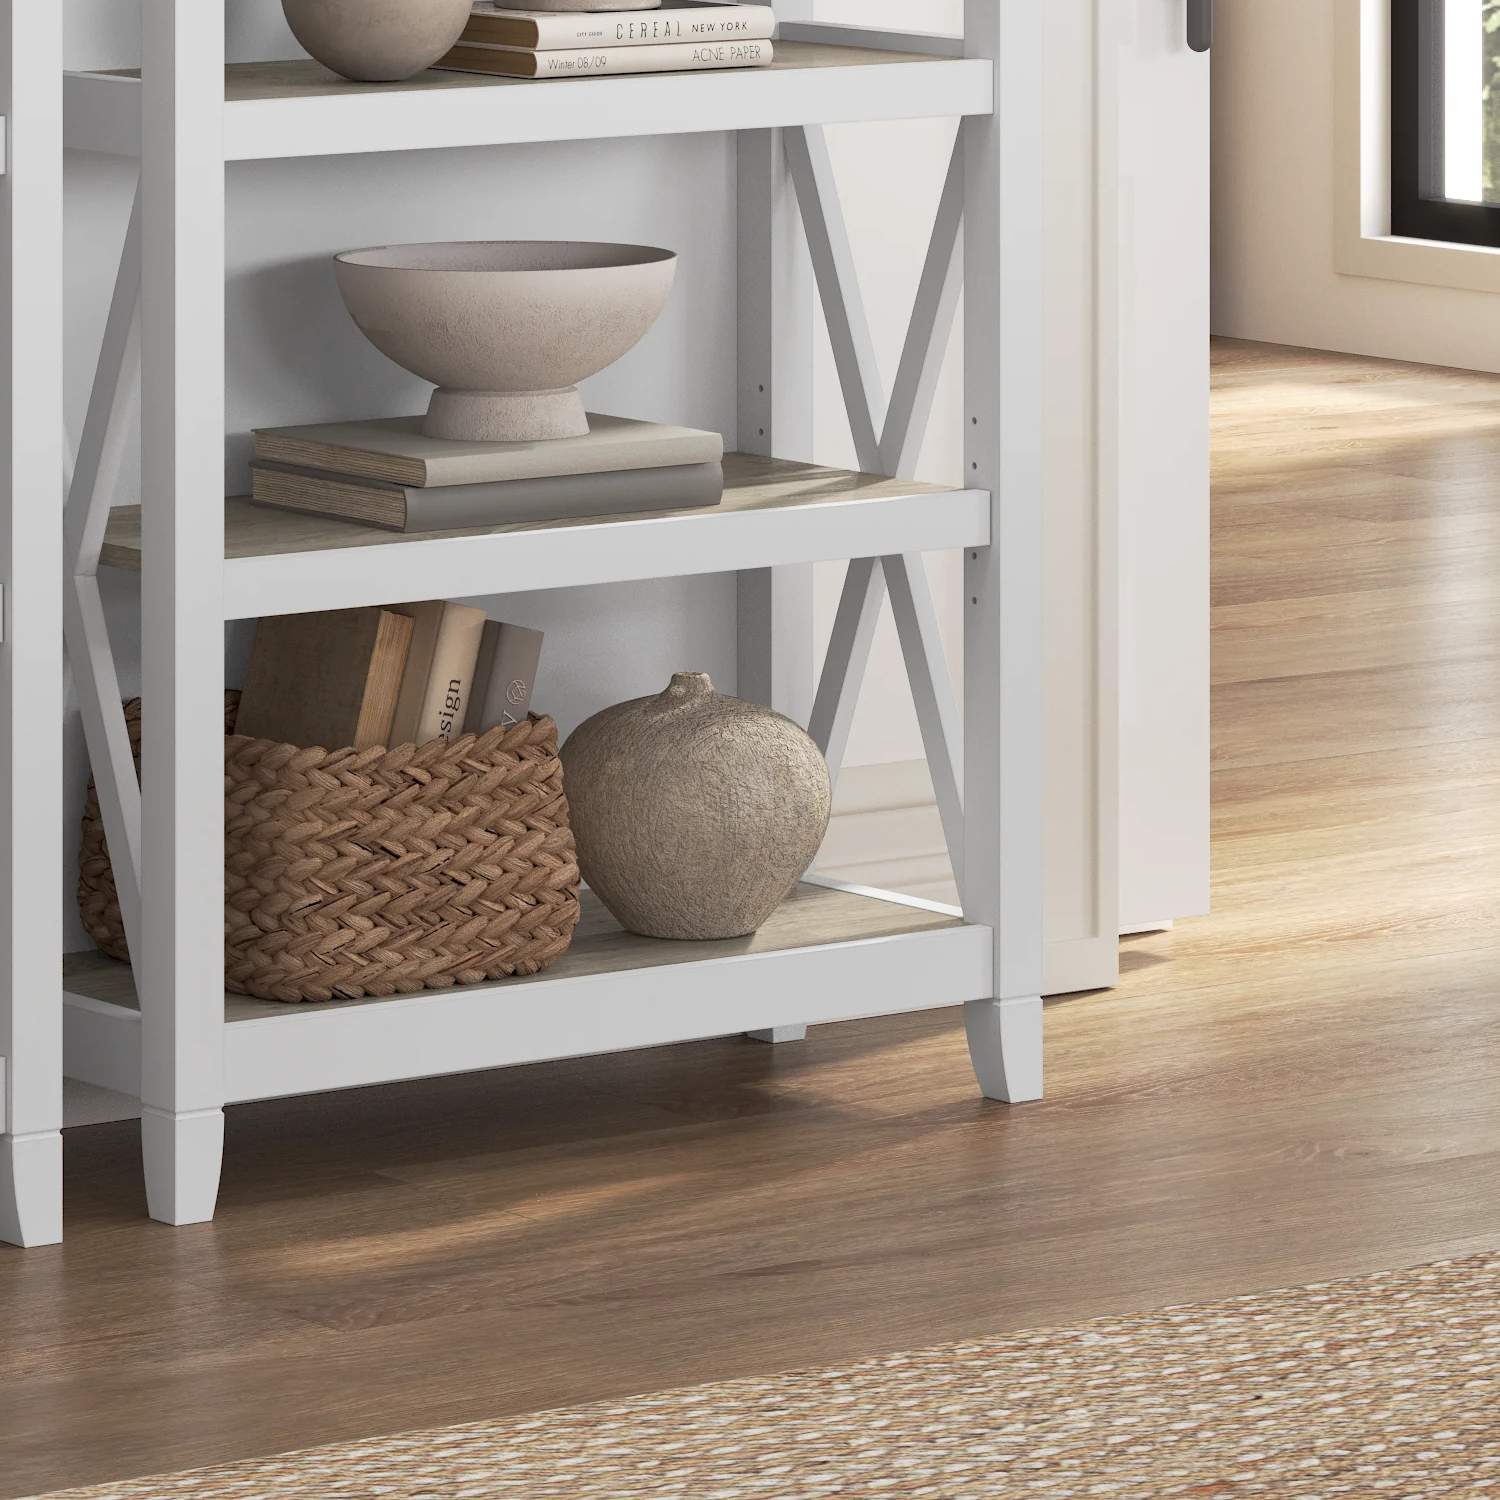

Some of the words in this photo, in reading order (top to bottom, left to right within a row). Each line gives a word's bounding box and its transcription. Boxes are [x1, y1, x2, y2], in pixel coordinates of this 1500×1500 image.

[616, 20, 682, 40] CEREAL
[691, 23, 716, 33] NEW
[719, 21, 748, 31] YORK
[692, 47, 724, 62] ACNE
[730, 45, 761, 60] PAPER
[548, 58, 575, 70] Winter
[577, 56, 607, 70] 08/09
